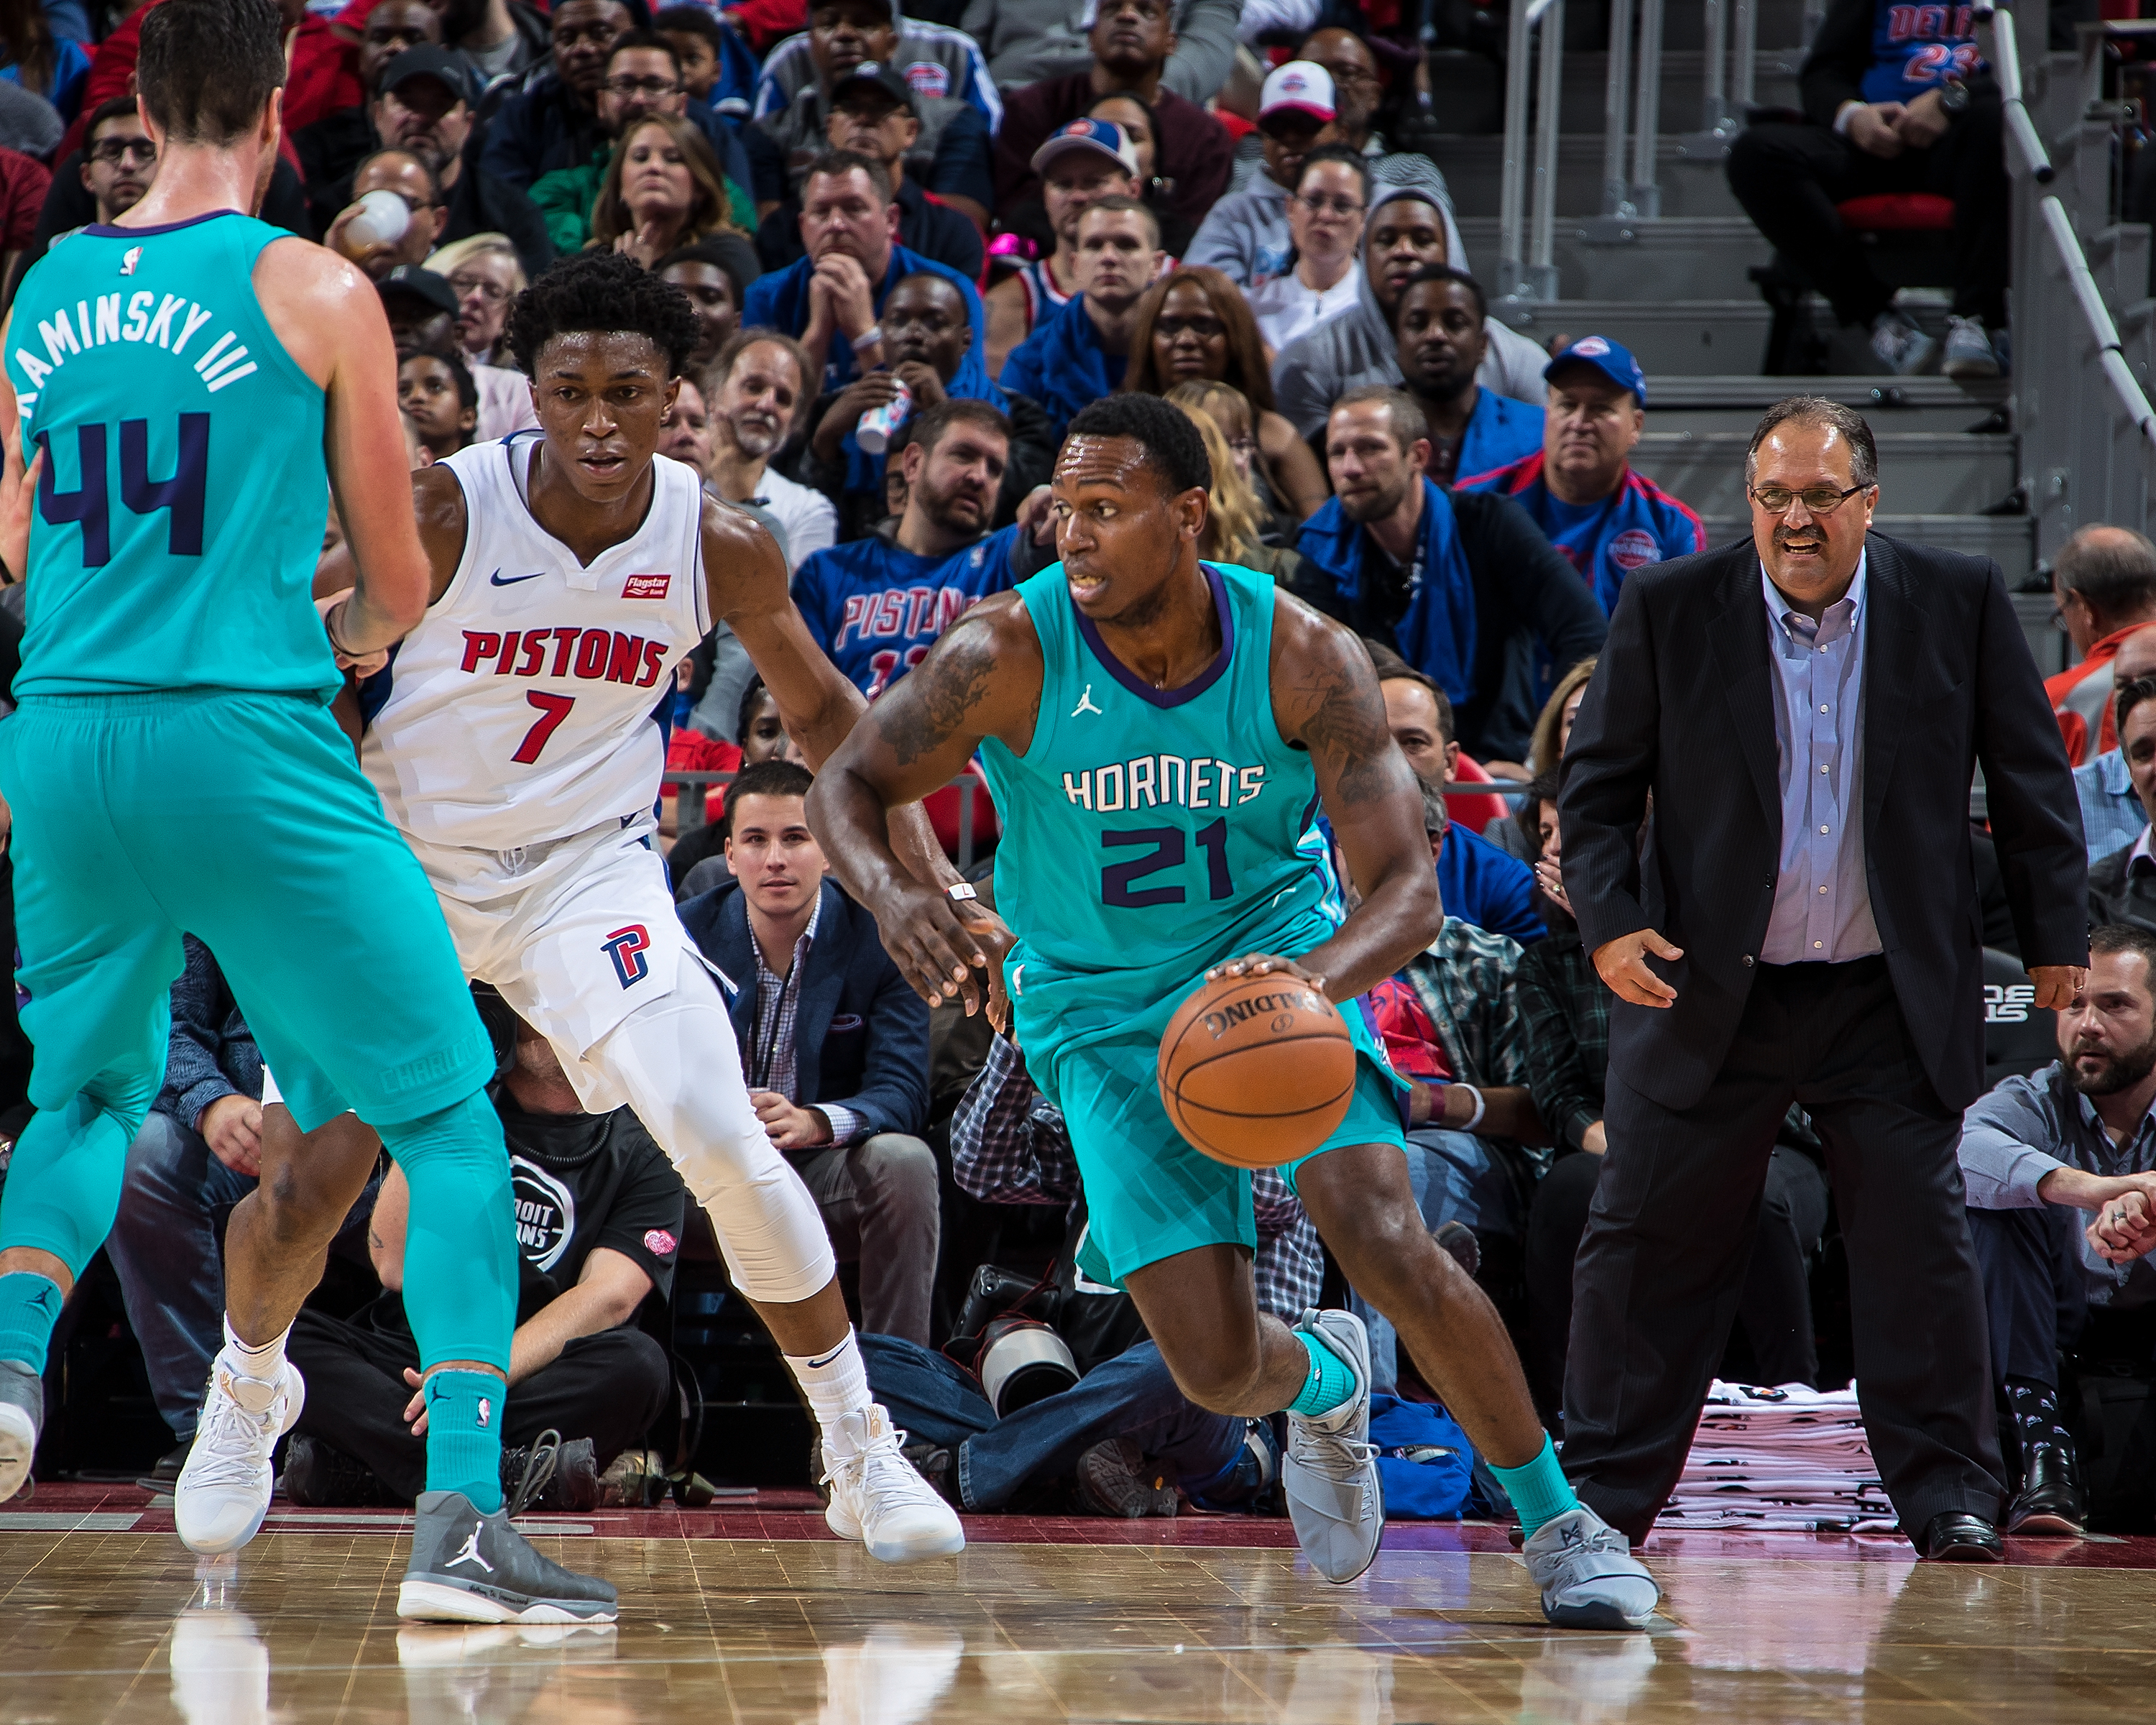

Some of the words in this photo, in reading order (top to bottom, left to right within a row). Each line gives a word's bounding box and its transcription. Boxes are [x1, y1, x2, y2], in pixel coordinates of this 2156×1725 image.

[193, 330, 258, 393] III
[33, 411, 211, 569] 44
[627, 577, 668, 589] Flagstar
[460, 627, 669, 688] PISTONS
[510, 689, 576, 765] 7
[1059, 753, 1272, 813] HORNETS
[1101, 815, 1235, 908] 21
